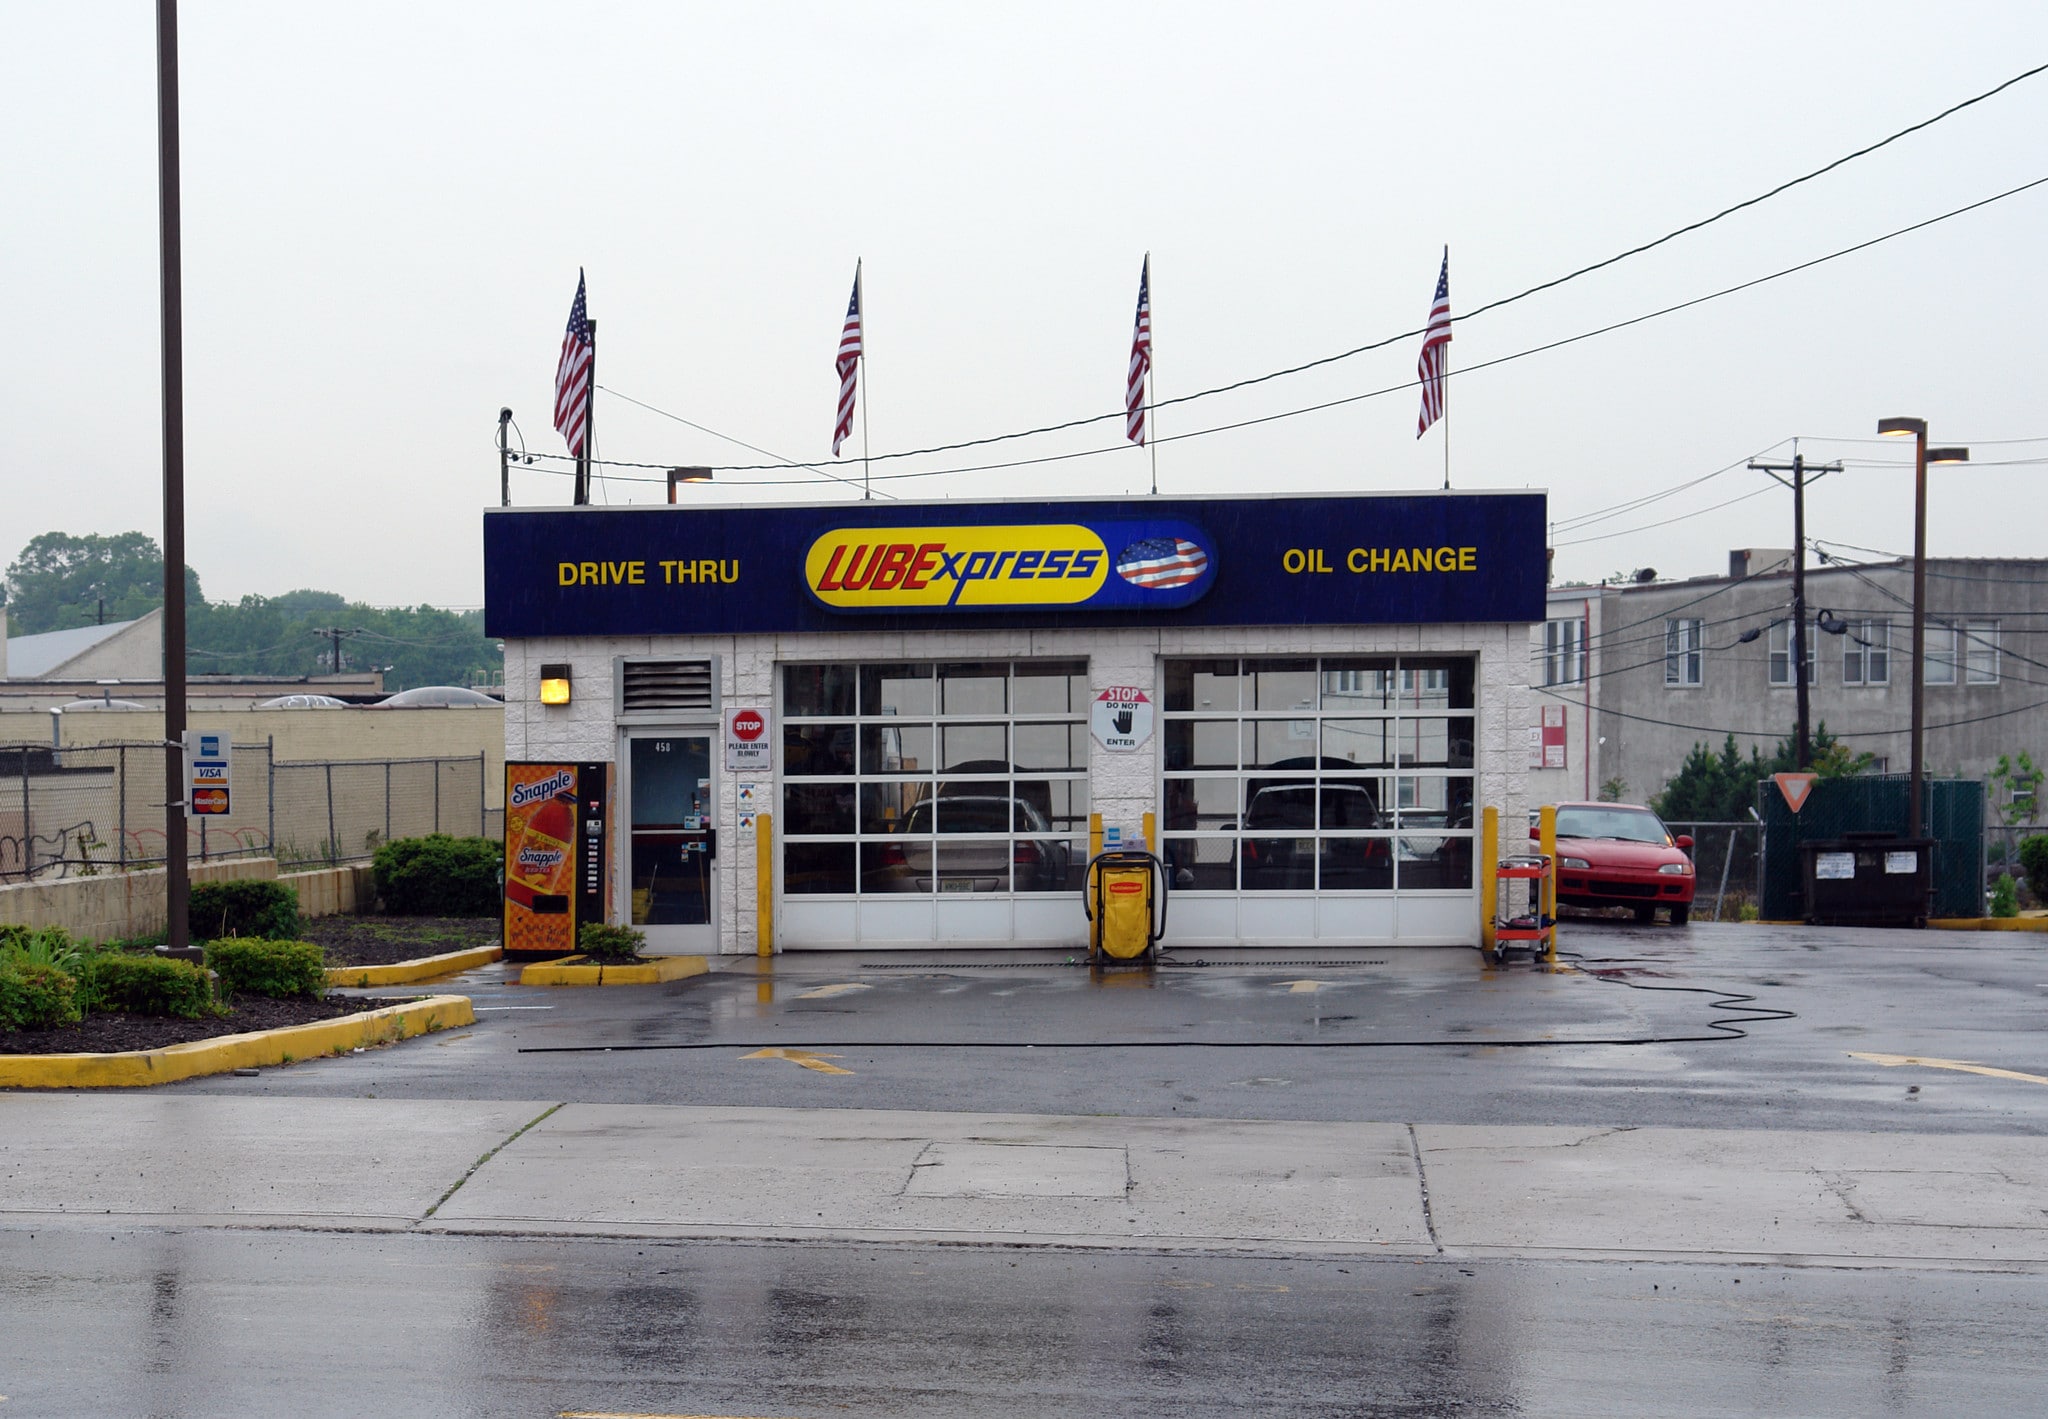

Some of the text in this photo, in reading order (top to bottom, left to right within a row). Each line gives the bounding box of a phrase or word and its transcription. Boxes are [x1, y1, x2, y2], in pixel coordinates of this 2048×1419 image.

[1282, 546, 1477, 574] OIL CHANGE
[558, 559, 739, 586] DRIVE THRU
[815, 542, 1105, 606] LUBExpress
[1107, 687, 1140, 701] STOP
[1121, 702, 1140, 710] NOT
[735, 721, 761, 731] STOP
[728, 742, 769, 750] PLEASE ENTER
[1106, 738, 1136, 746] ENTER
[199, 768, 222, 778] VISA
[511, 770, 571, 805] Snapple
[520, 847, 562, 867] Snapple
